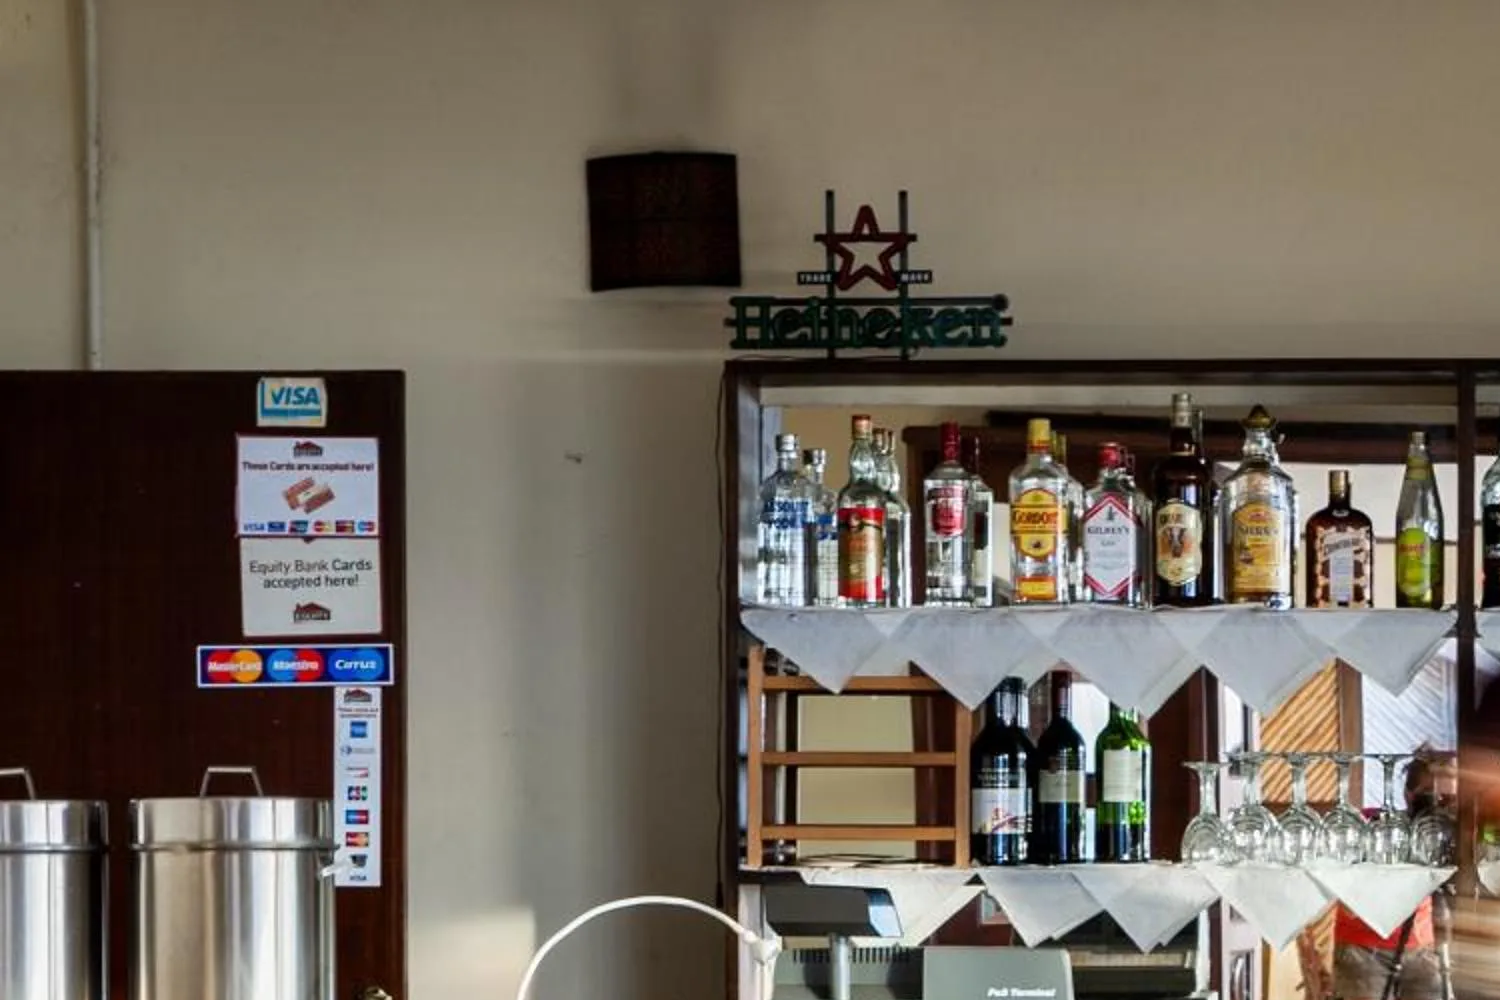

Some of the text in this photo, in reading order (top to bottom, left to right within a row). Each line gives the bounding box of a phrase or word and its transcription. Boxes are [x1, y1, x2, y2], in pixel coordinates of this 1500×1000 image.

[729, 296, 1008, 349] Heineken
[271, 386, 320, 405] VISA
[249, 558, 373, 574] Equity Bank Cards
[263, 574, 359, 590] accepted here!
[208, 660, 262, 672] MasterCard
[335, 659, 377, 670] Cirrus
